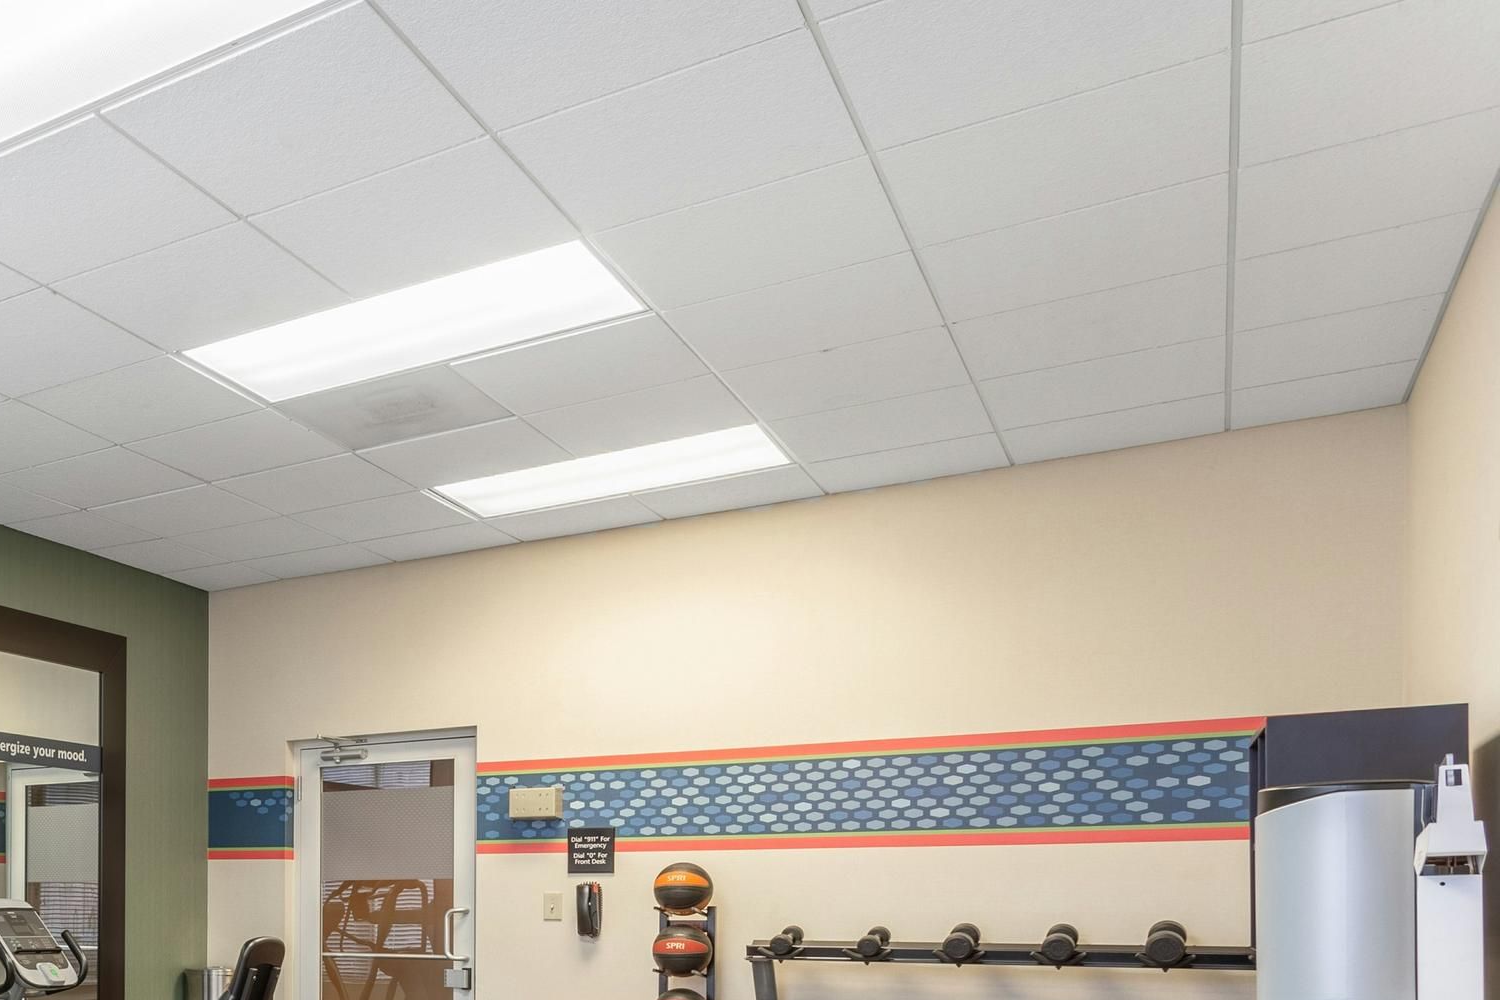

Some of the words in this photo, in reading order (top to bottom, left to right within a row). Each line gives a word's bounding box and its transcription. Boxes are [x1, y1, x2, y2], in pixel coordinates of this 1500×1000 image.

[33, 746, 56, 759] your
[57, 750, 88, 763] mood.
[667, 874, 686, 882] SPRI
[665, 942, 685, 950] SPRI
